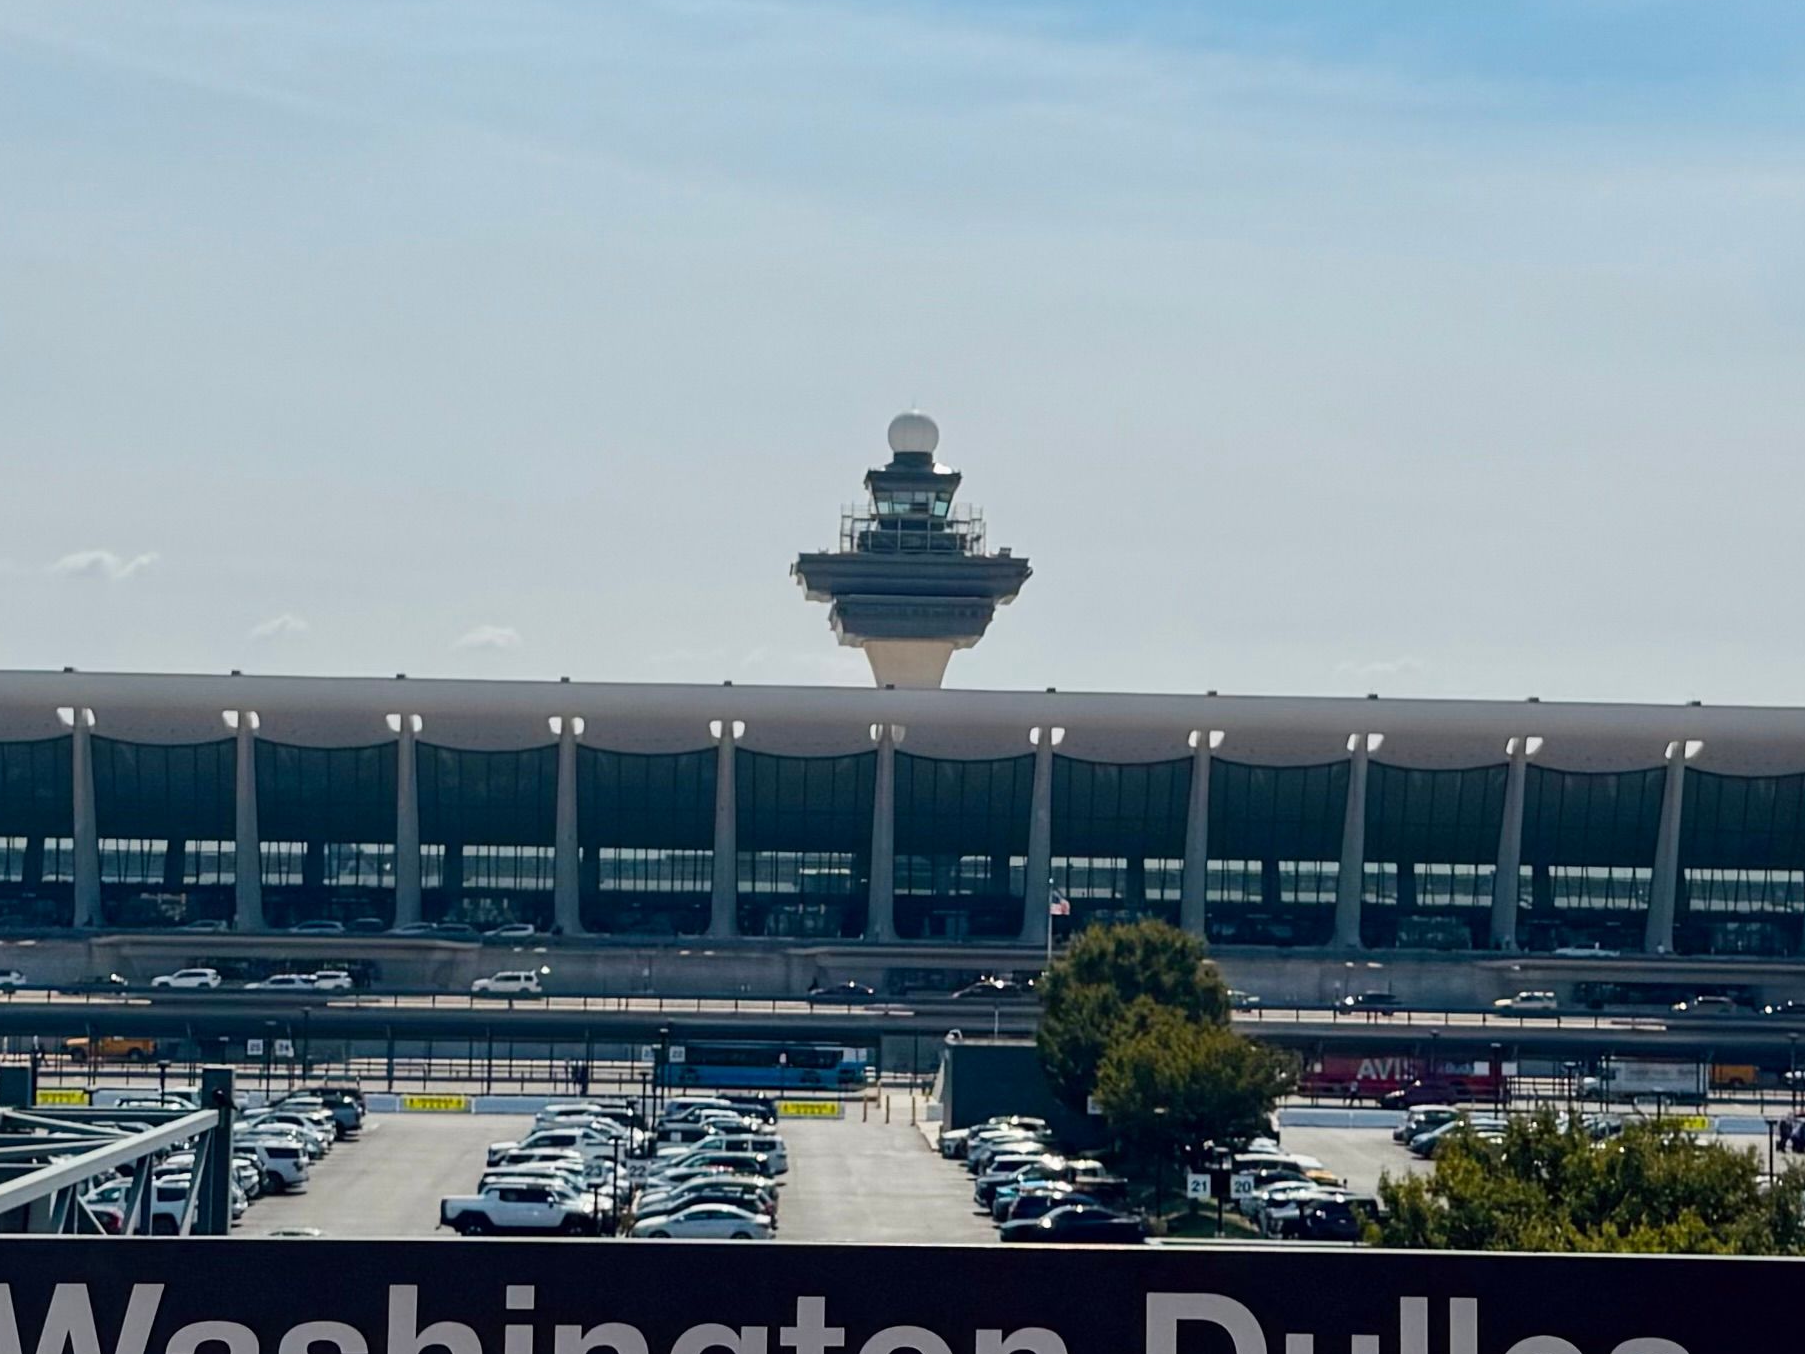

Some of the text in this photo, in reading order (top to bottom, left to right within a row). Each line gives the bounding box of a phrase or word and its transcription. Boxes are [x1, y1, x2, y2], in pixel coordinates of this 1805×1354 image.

[585, 1165, 601, 1178] 23
[629, 1165, 646, 1178] 22
[1191, 1179, 1207, 1192] 21
[1234, 1180, 1251, 1193] 20
